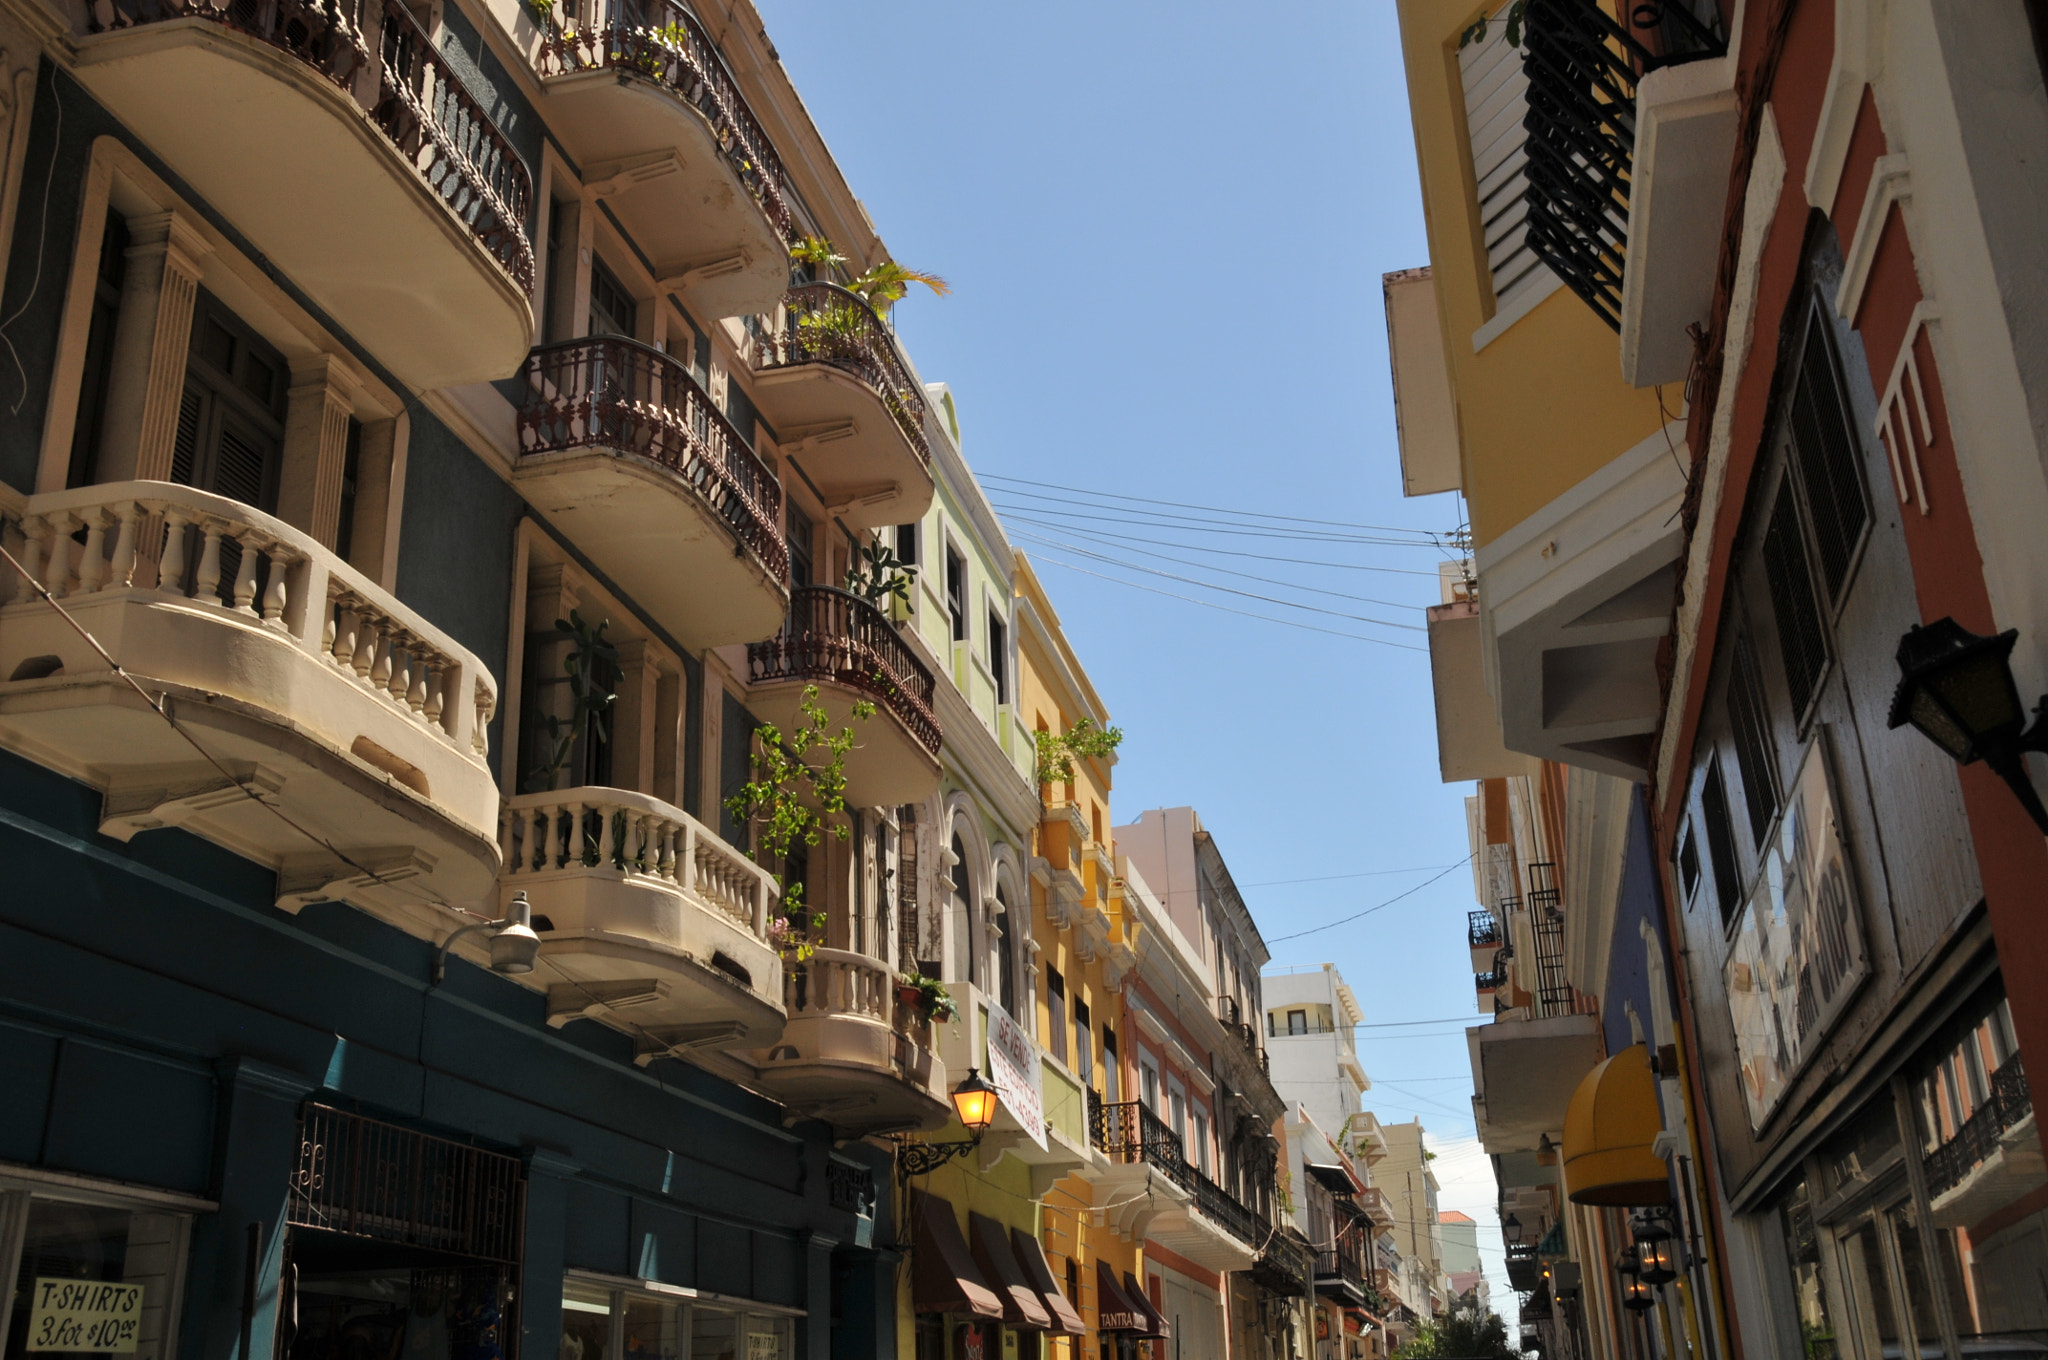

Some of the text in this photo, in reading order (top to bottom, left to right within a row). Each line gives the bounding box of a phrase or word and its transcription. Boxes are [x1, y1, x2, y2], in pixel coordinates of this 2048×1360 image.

[999, 1016, 1031, 1074] SE VENDE
[989, 1039, 1039, 1111] ESTE EDIFICIO
[36, 1316, 55, 1347] 3
[49, 1317, 84, 1347] for
[1100, 1312, 1133, 1328] TANTRA
